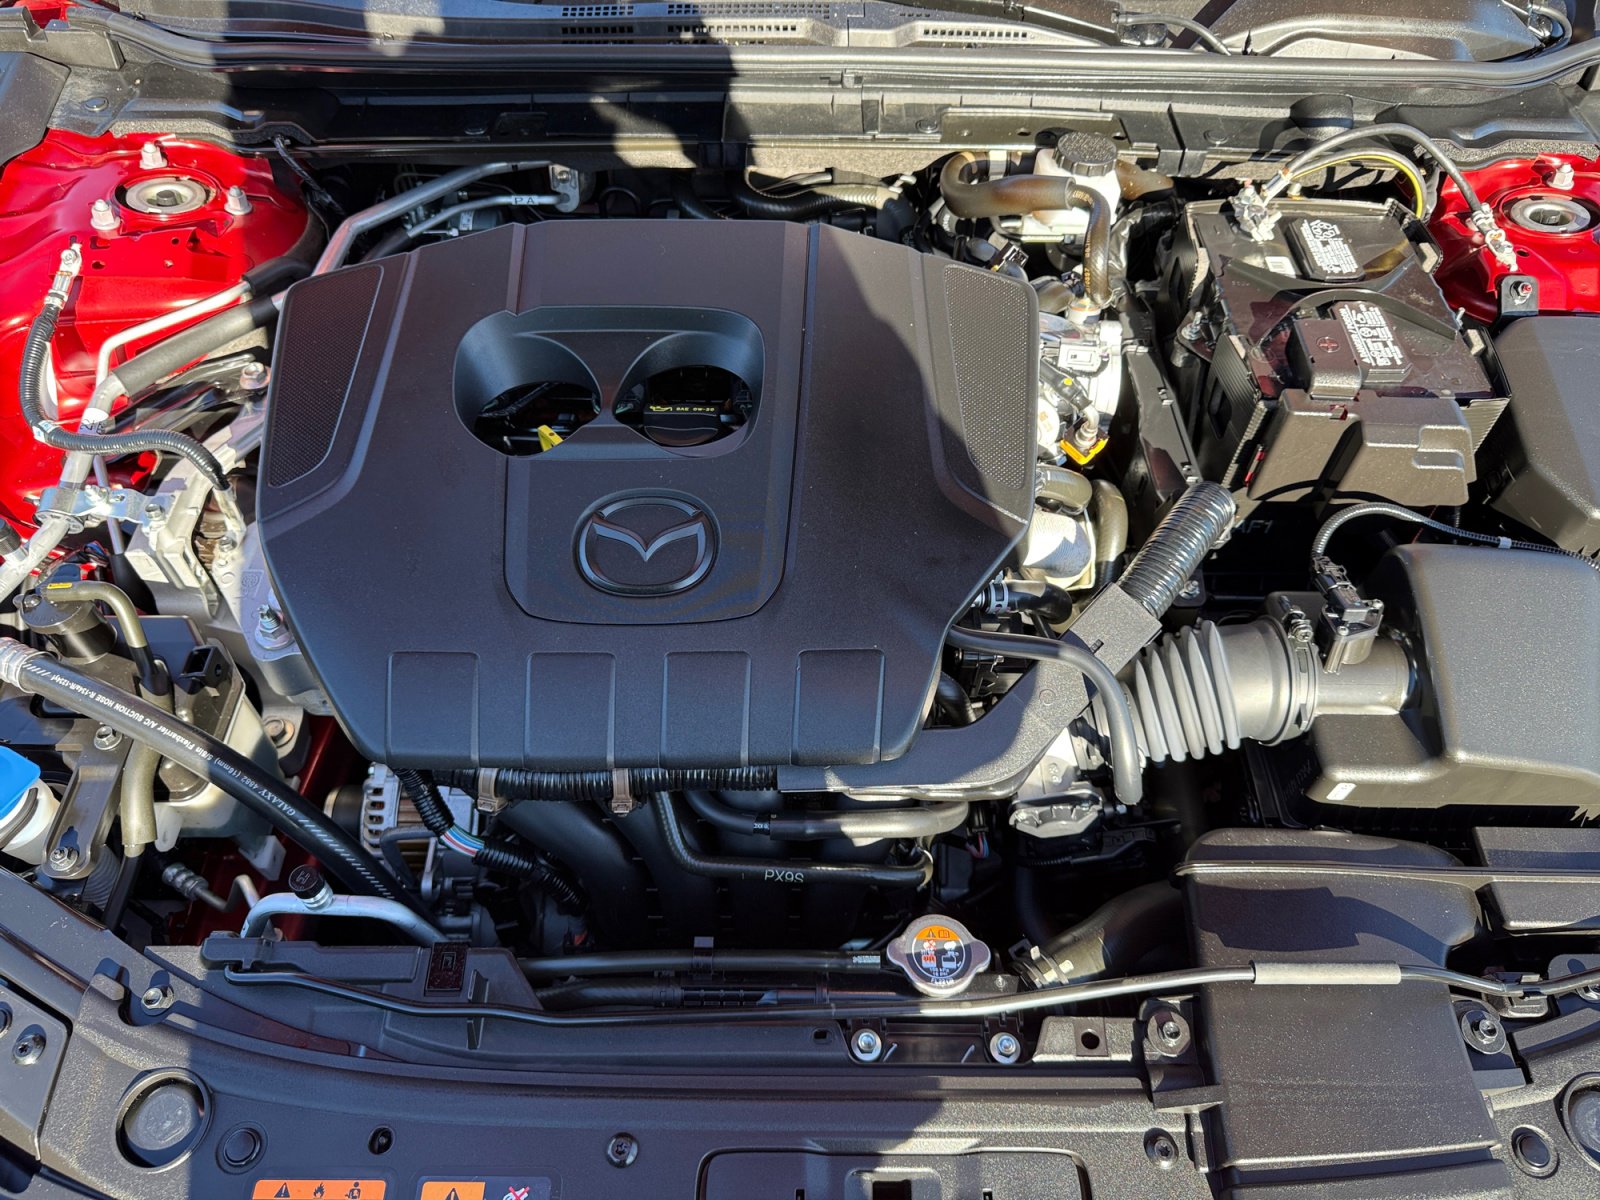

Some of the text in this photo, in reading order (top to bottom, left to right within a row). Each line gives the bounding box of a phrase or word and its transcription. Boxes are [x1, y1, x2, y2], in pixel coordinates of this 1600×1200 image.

[50, 674, 96, 699] R-134a/R-1234yf
[95, 694, 115, 708] HOSE
[114, 703, 145, 722] SUCTION
[143, 718, 158, 729] A/C
[156, 725, 195, 750] Flexbarrier
[214, 757, 242, 778] (16mm)
[258, 788, 296, 816] GALAXY
